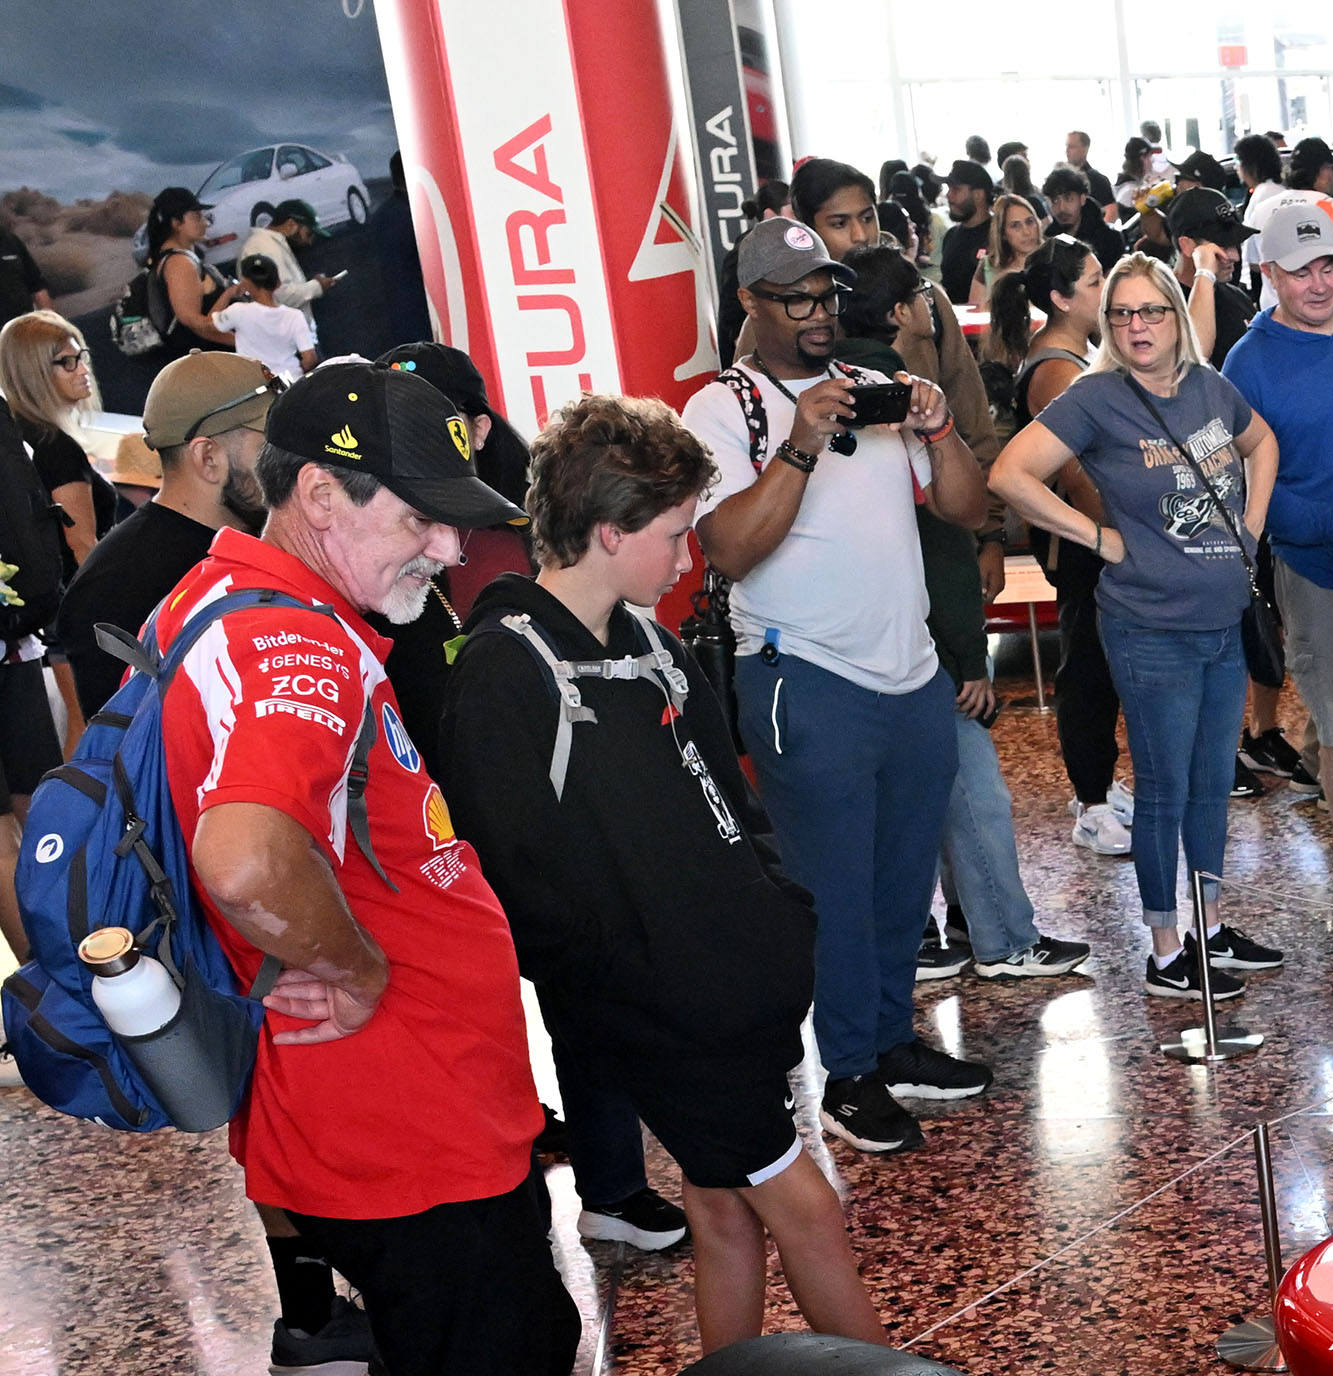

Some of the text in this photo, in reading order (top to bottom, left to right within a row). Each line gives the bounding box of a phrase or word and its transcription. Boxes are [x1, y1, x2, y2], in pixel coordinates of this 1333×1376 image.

[705, 104, 748, 251] CURA
[324, 444, 363, 461] Santander
[254, 698, 346, 737] PIRELLI
